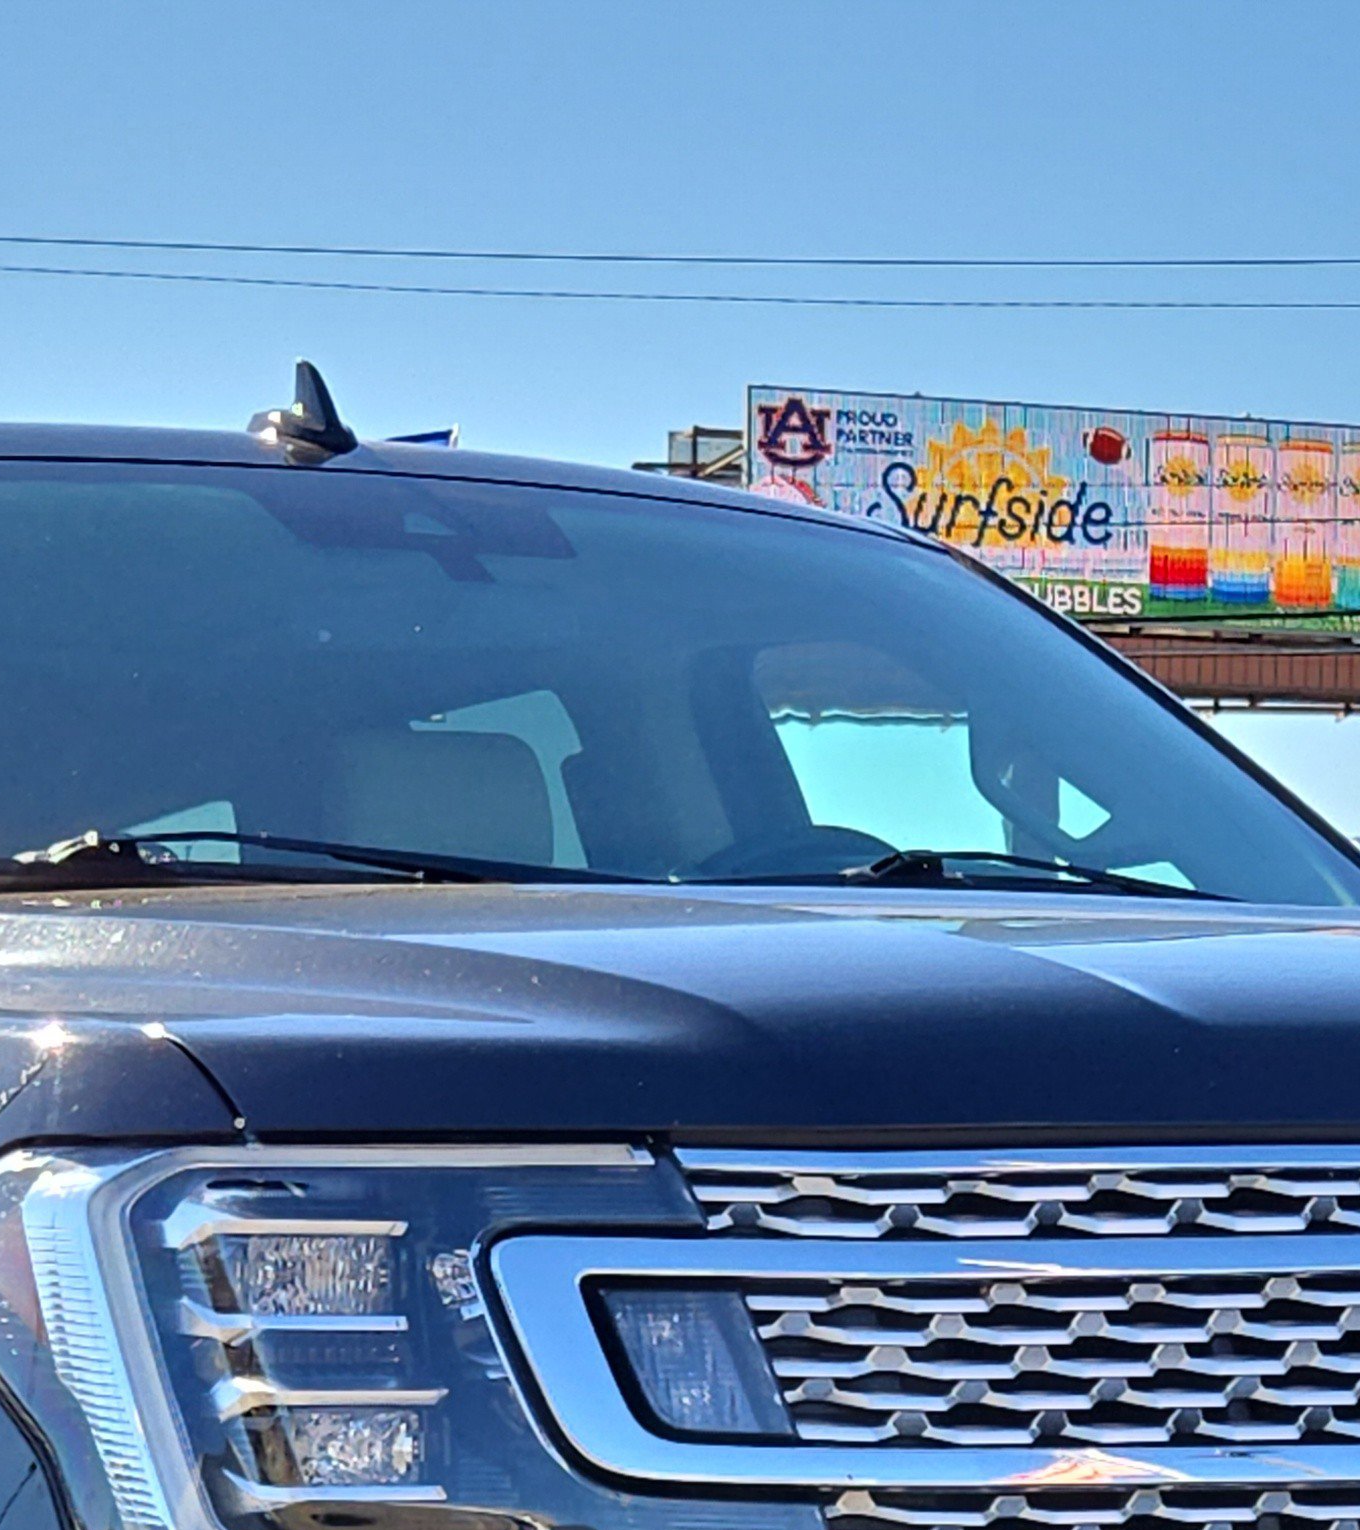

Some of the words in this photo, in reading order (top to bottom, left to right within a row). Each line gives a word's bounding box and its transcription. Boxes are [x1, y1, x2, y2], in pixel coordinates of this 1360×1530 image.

[836, 409, 898, 428] PROUD
[836, 428, 915, 447] PARTNER
[867, 461, 1114, 547] Surfside
